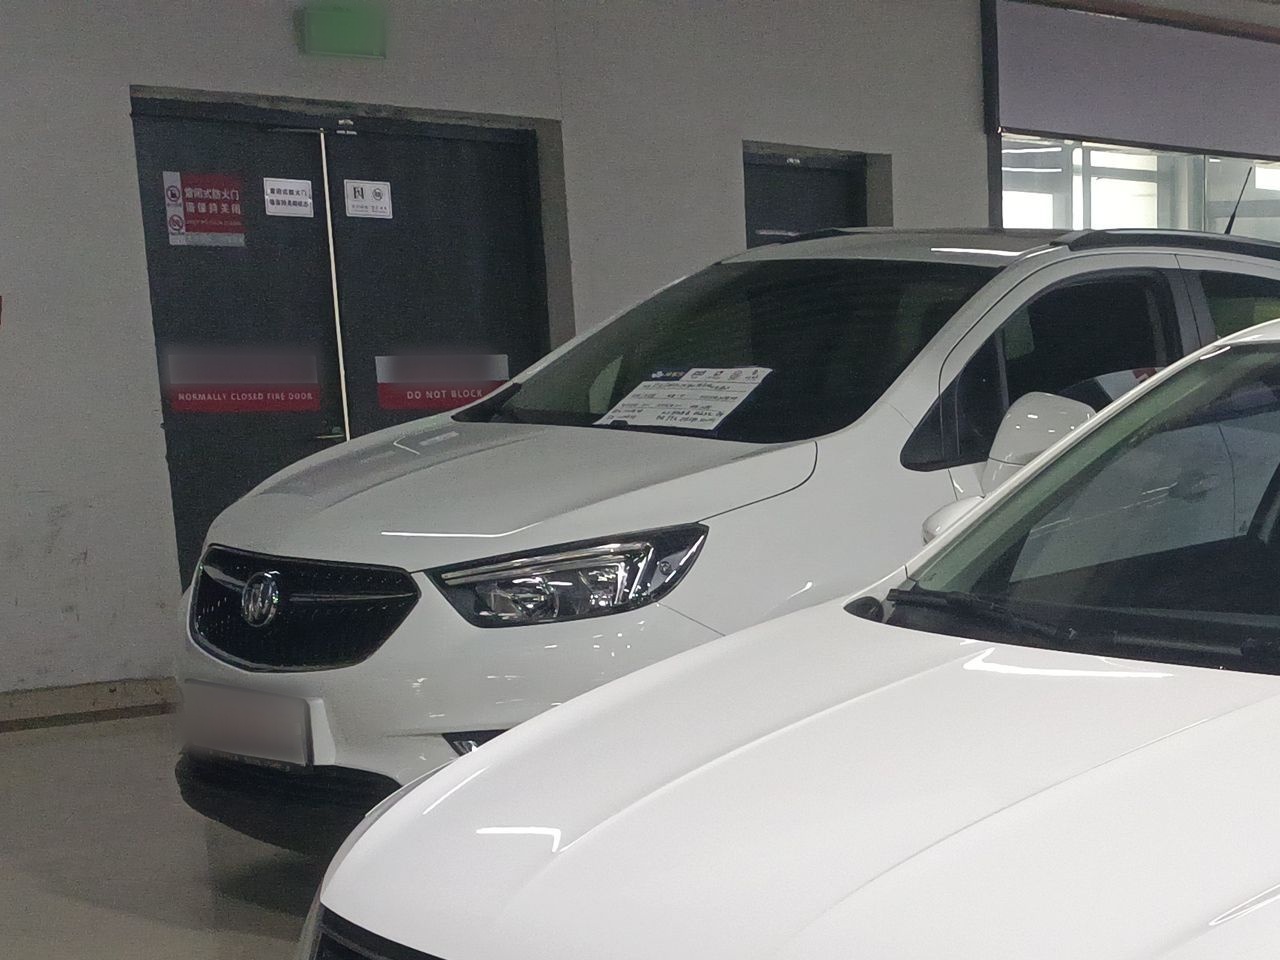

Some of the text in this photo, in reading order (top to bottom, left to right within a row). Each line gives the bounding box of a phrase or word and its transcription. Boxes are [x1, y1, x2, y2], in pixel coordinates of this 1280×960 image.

[178, 391, 313, 401] NORMALLY CLOSED FIRE DOOR
[406, 389, 483, 400] DO NOT BLOCK
